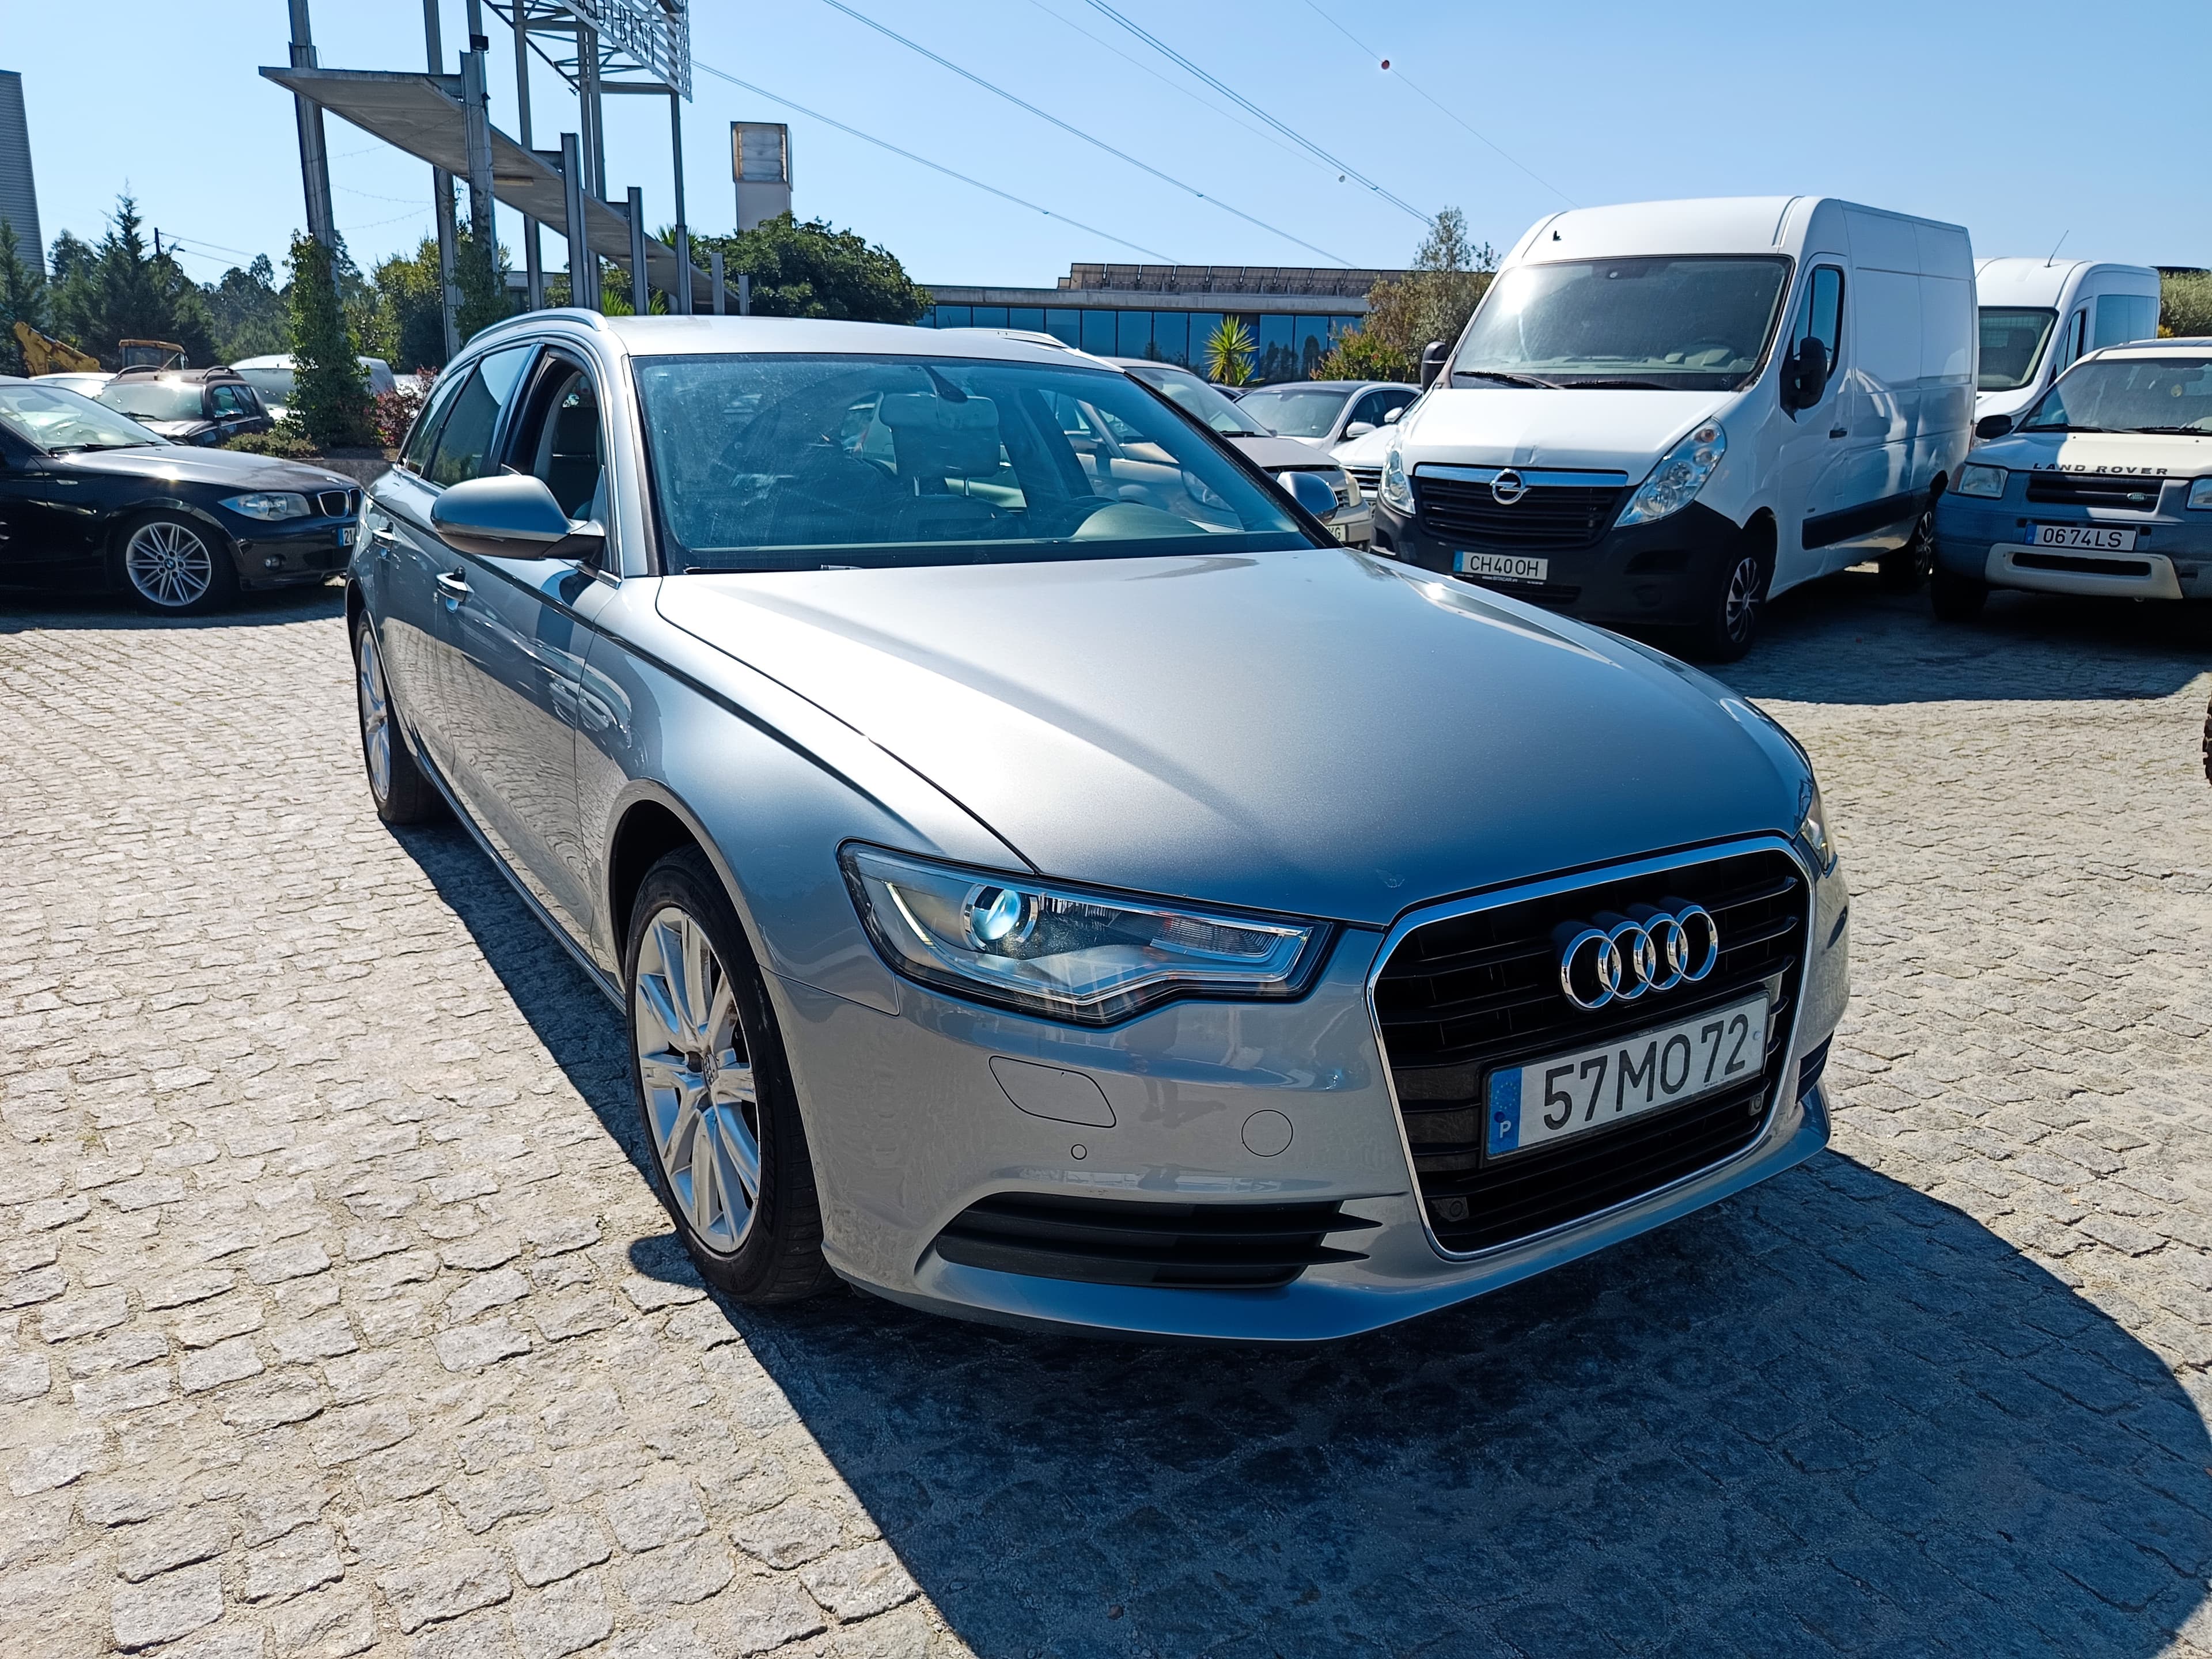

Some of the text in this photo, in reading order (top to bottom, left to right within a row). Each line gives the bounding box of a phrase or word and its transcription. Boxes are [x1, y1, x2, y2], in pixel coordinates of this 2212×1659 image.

[2033, 463, 2168, 475] LAND ROVER
[2043, 528, 2123, 548] 0674LS
[1470, 555, 1539, 577] CH40OH
[1543, 1014, 1749, 1131] 57MO72
[1499, 1120, 1512, 1139] P
